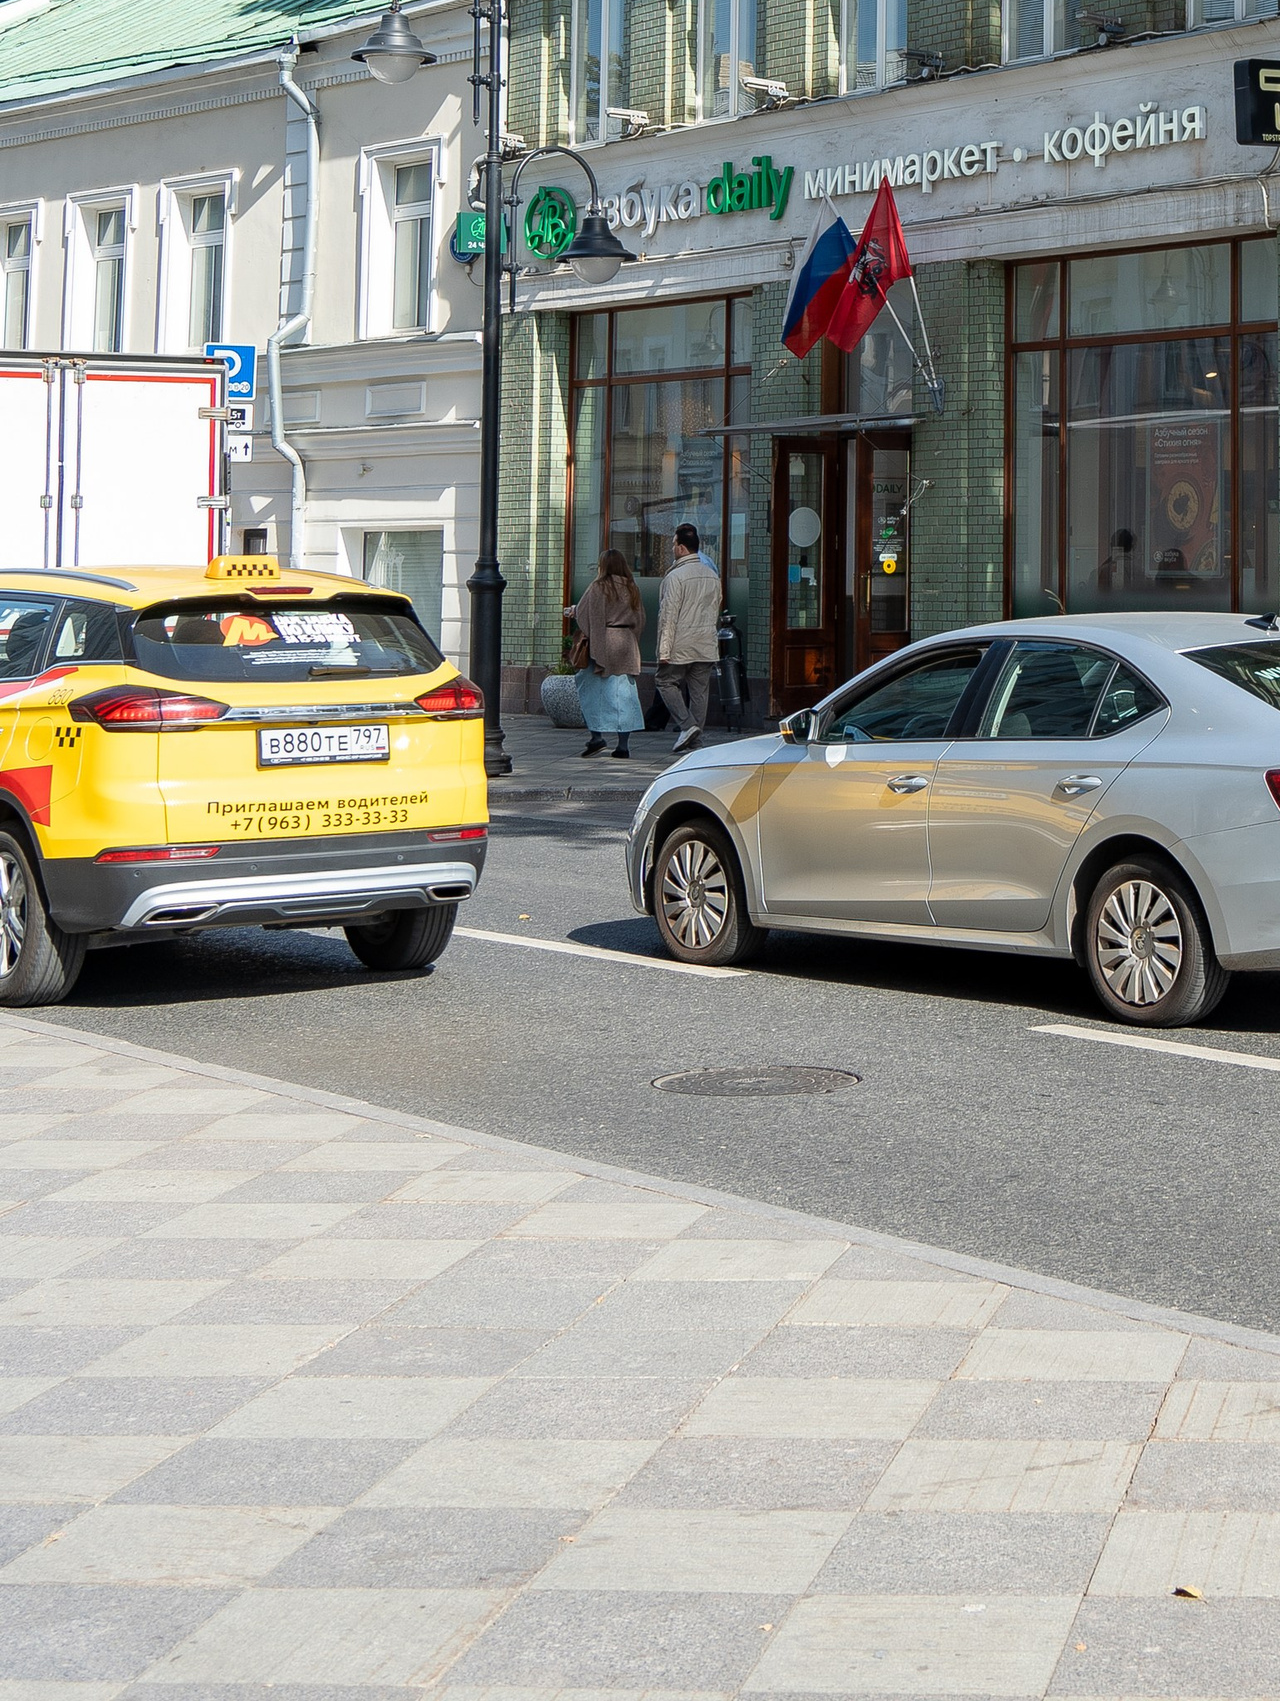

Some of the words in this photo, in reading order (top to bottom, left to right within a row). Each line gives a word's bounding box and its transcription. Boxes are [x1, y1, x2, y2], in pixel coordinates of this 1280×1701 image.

[706, 155, 794, 220] daily
[804, 140, 1003, 199] минимаркет
[1043, 102, 1207, 167] кофейня
[467, 241, 479, 249] 24
[876, 484, 903, 494] DAILY
[48, 689, 74, 705] 880
[270, 732, 348, 754] В880ТЕ
[353, 728, 381, 744] 797
[207, 800, 330, 816] Приглашаем
[337, 791, 428, 809] водителей
[322, 809, 408, 828] 333-33-33
